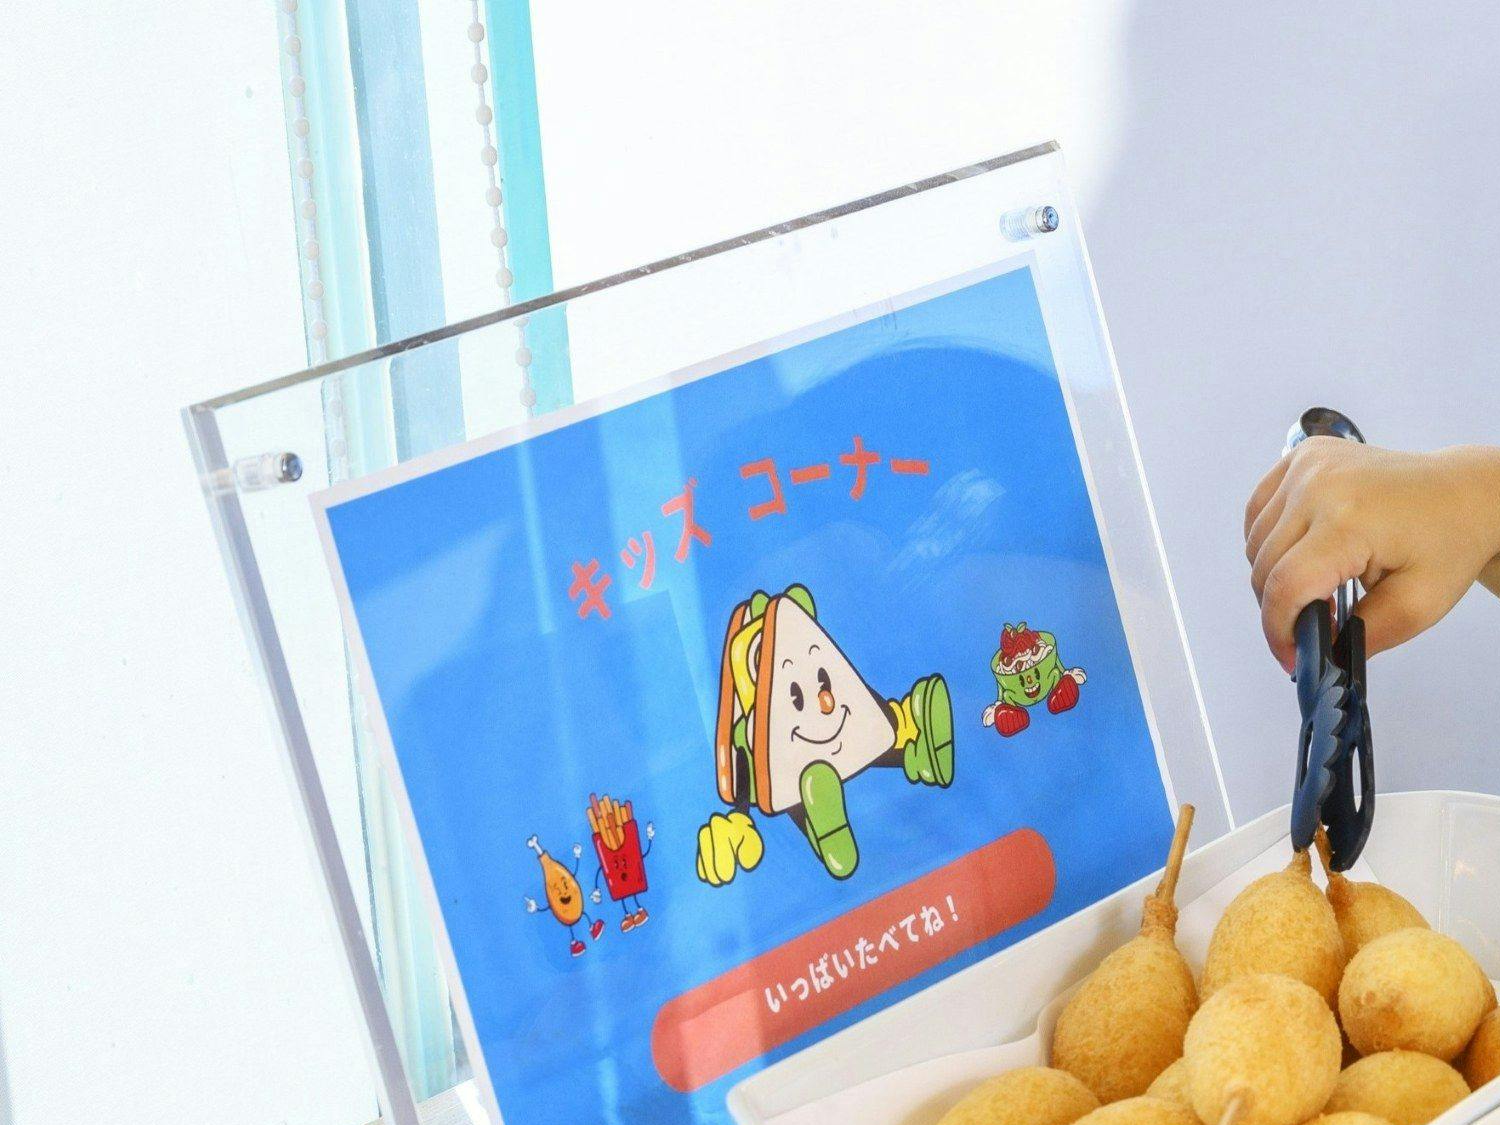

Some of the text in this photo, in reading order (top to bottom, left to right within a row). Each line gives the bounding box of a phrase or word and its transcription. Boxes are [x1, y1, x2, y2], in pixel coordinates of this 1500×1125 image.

[568, 434, 930, 619] キッズ コーナー
[764, 895, 959, 1013] いっぱいたべてね！
